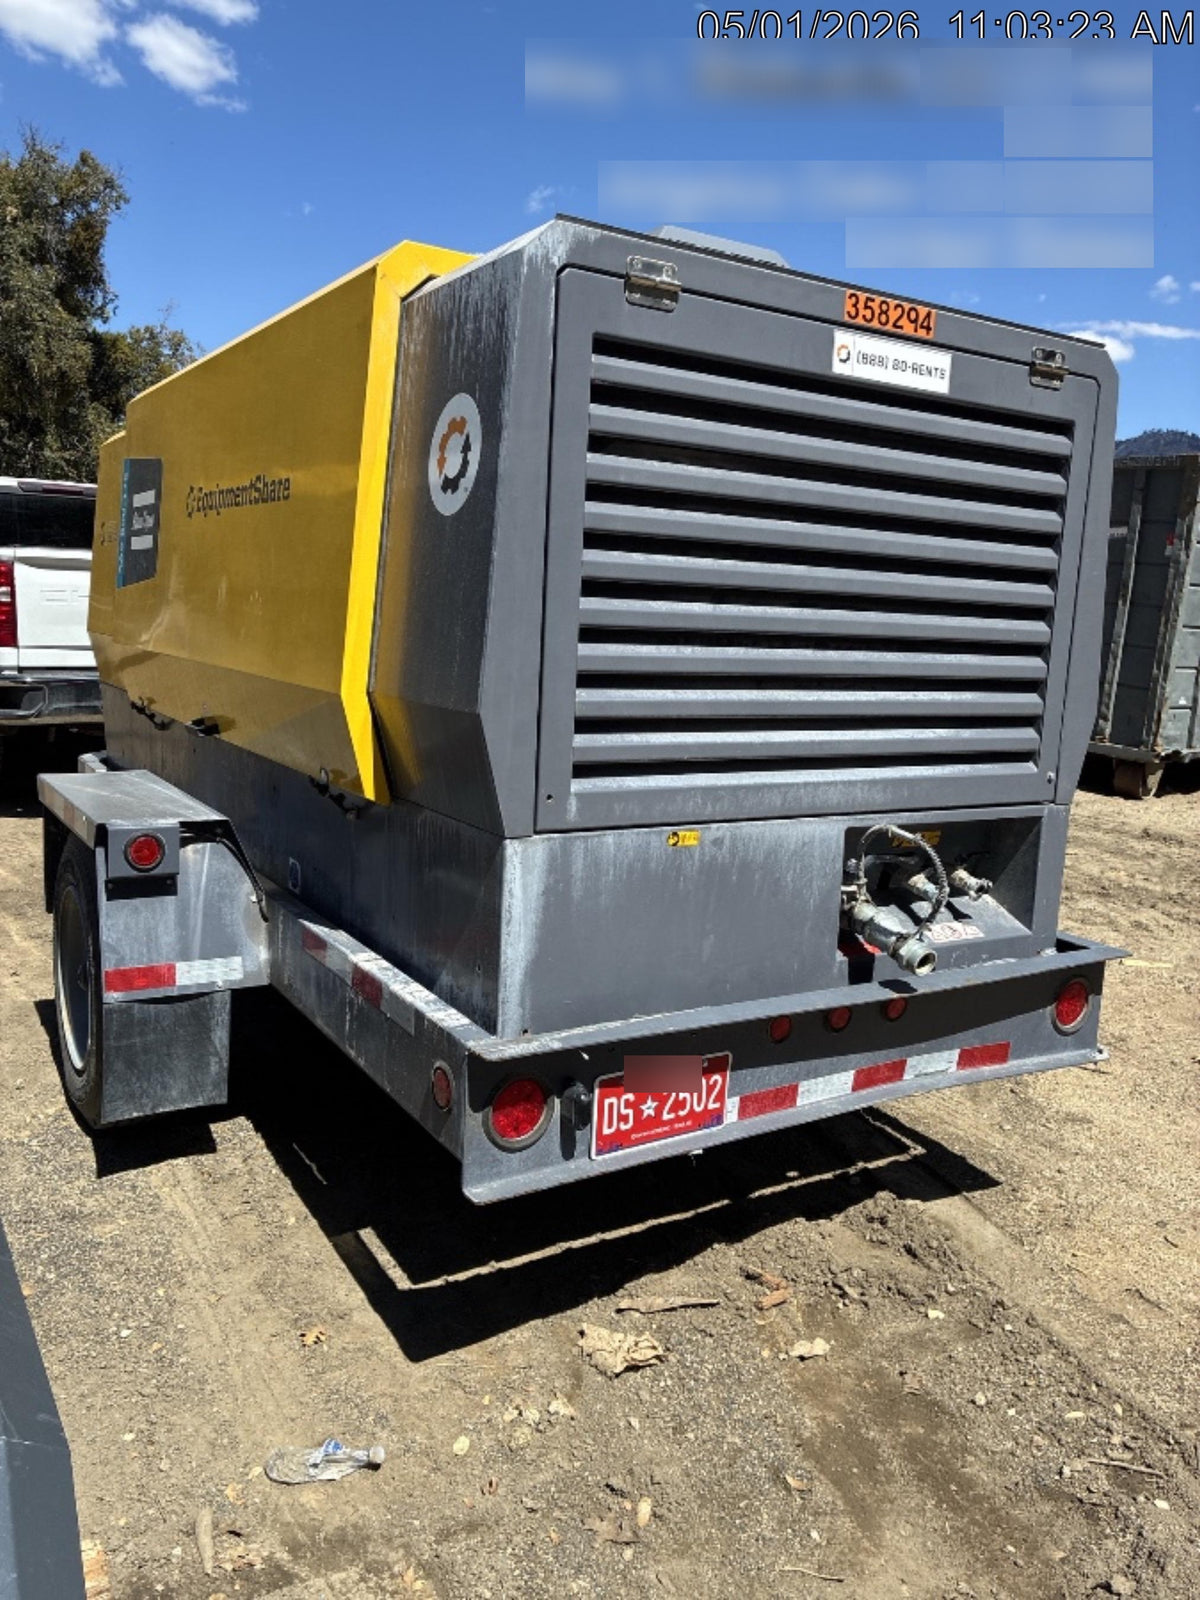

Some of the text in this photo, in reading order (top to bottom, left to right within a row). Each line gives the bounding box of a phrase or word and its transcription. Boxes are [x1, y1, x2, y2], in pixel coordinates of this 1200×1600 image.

[846, 292, 932, 336] 358294
[196, 474, 291, 518] EquipmentShare
[602, 1093, 635, 1136] DS
